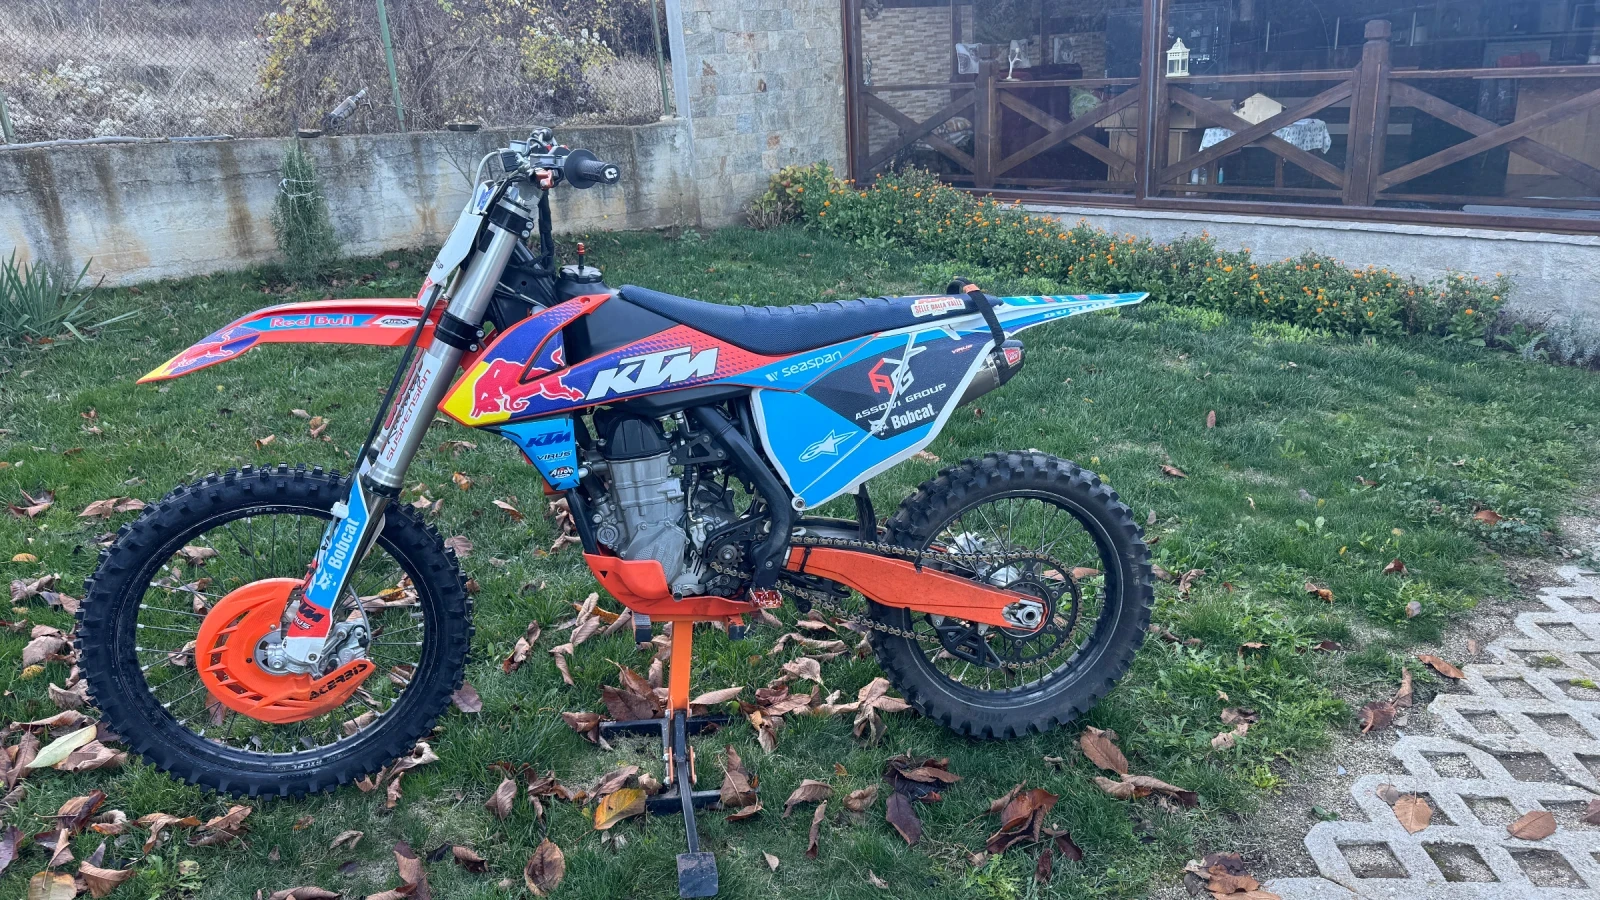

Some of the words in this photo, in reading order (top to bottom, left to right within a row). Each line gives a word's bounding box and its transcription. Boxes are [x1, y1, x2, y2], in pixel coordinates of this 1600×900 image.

[270, 314, 311, 328] Red
[314, 315, 355, 326] Bull
[585, 345, 719, 400] KTM
[781, 350, 843, 377] seaspan
[905, 383, 947, 403] GROUP
[890, 403, 935, 429] Bobcat
[525, 430, 571, 447] KTM
[536, 450, 573, 461] VIRUS
[550, 466, 574, 477] Airoh
[327, 517, 360, 570] Bobcat
[298, 599, 325, 622] TM
[309, 663, 368, 701] ACERBIS
